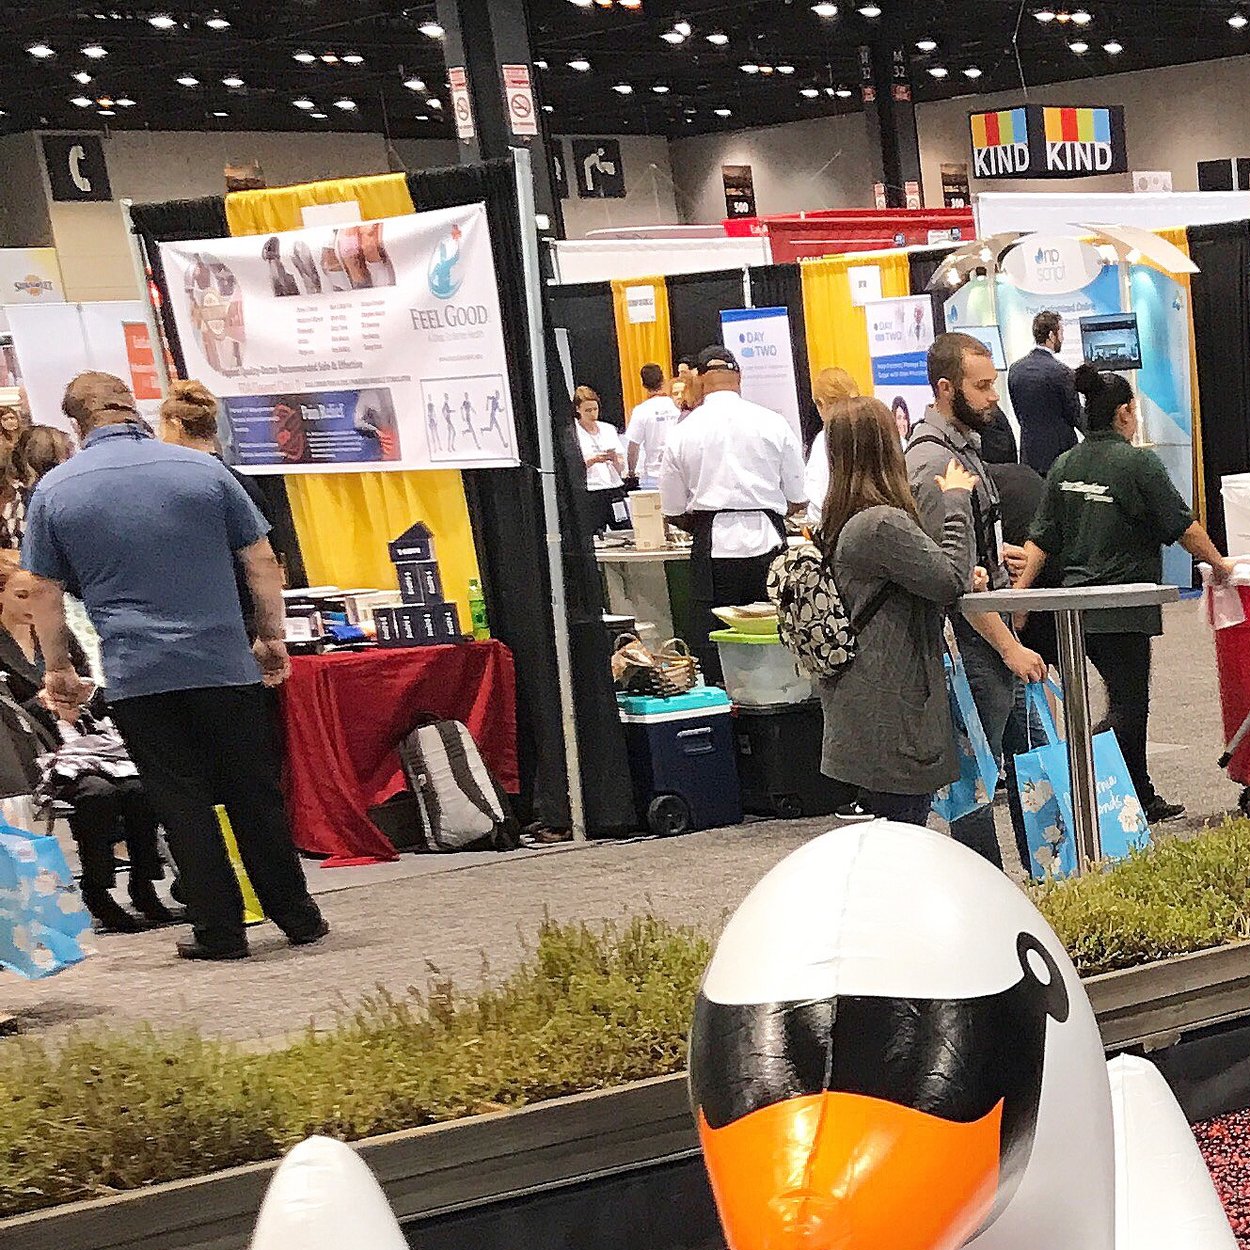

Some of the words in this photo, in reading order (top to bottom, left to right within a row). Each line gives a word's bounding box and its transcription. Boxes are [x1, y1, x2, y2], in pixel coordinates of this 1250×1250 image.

[974, 142, 1030, 177] KIND
[1045, 141, 1113, 171] KIND
[409, 309, 444, 330] FEEL
[444, 305, 488, 327] GOOD
[746, 332, 765, 344] DAY
[754, 345, 777, 356] TWO
